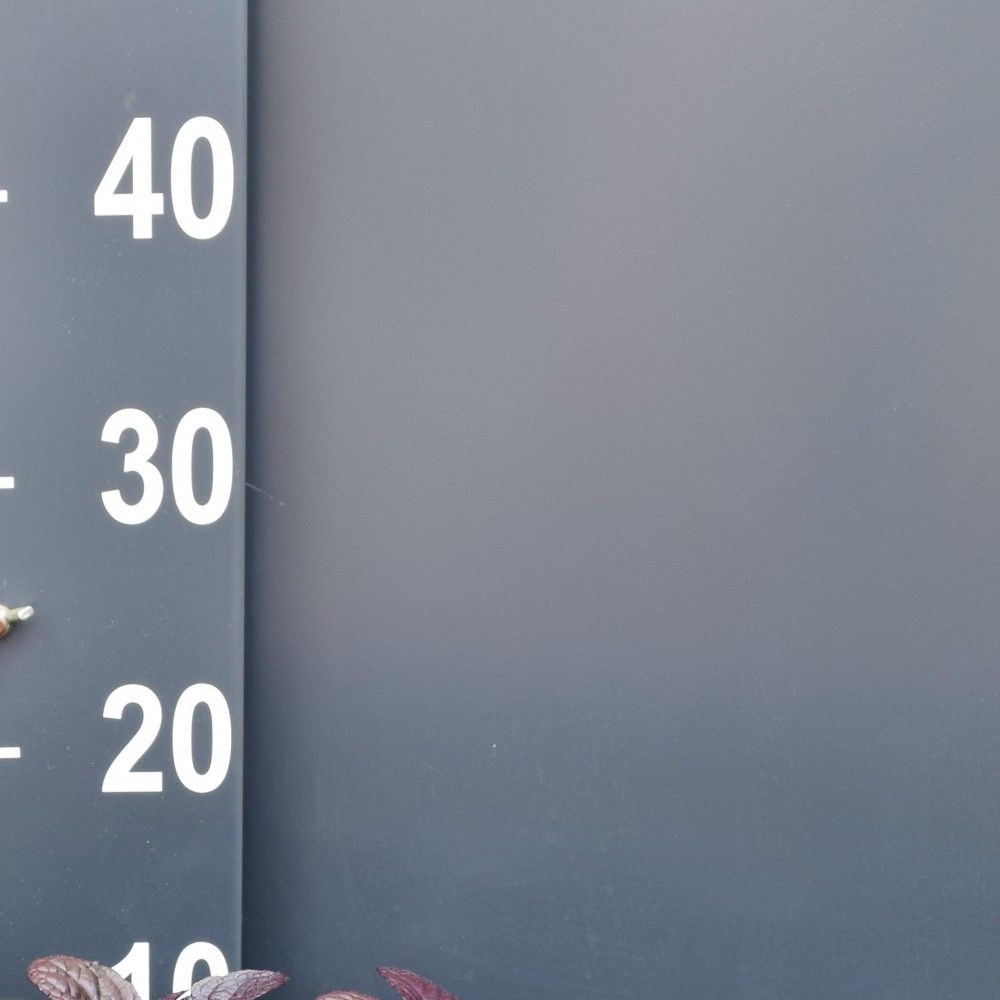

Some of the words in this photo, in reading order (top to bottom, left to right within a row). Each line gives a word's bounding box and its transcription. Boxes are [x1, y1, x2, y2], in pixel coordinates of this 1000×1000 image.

[94, 116, 234, 240] 40
[101, 408, 233, 525] 30
[102, 683, 231, 793] 20
